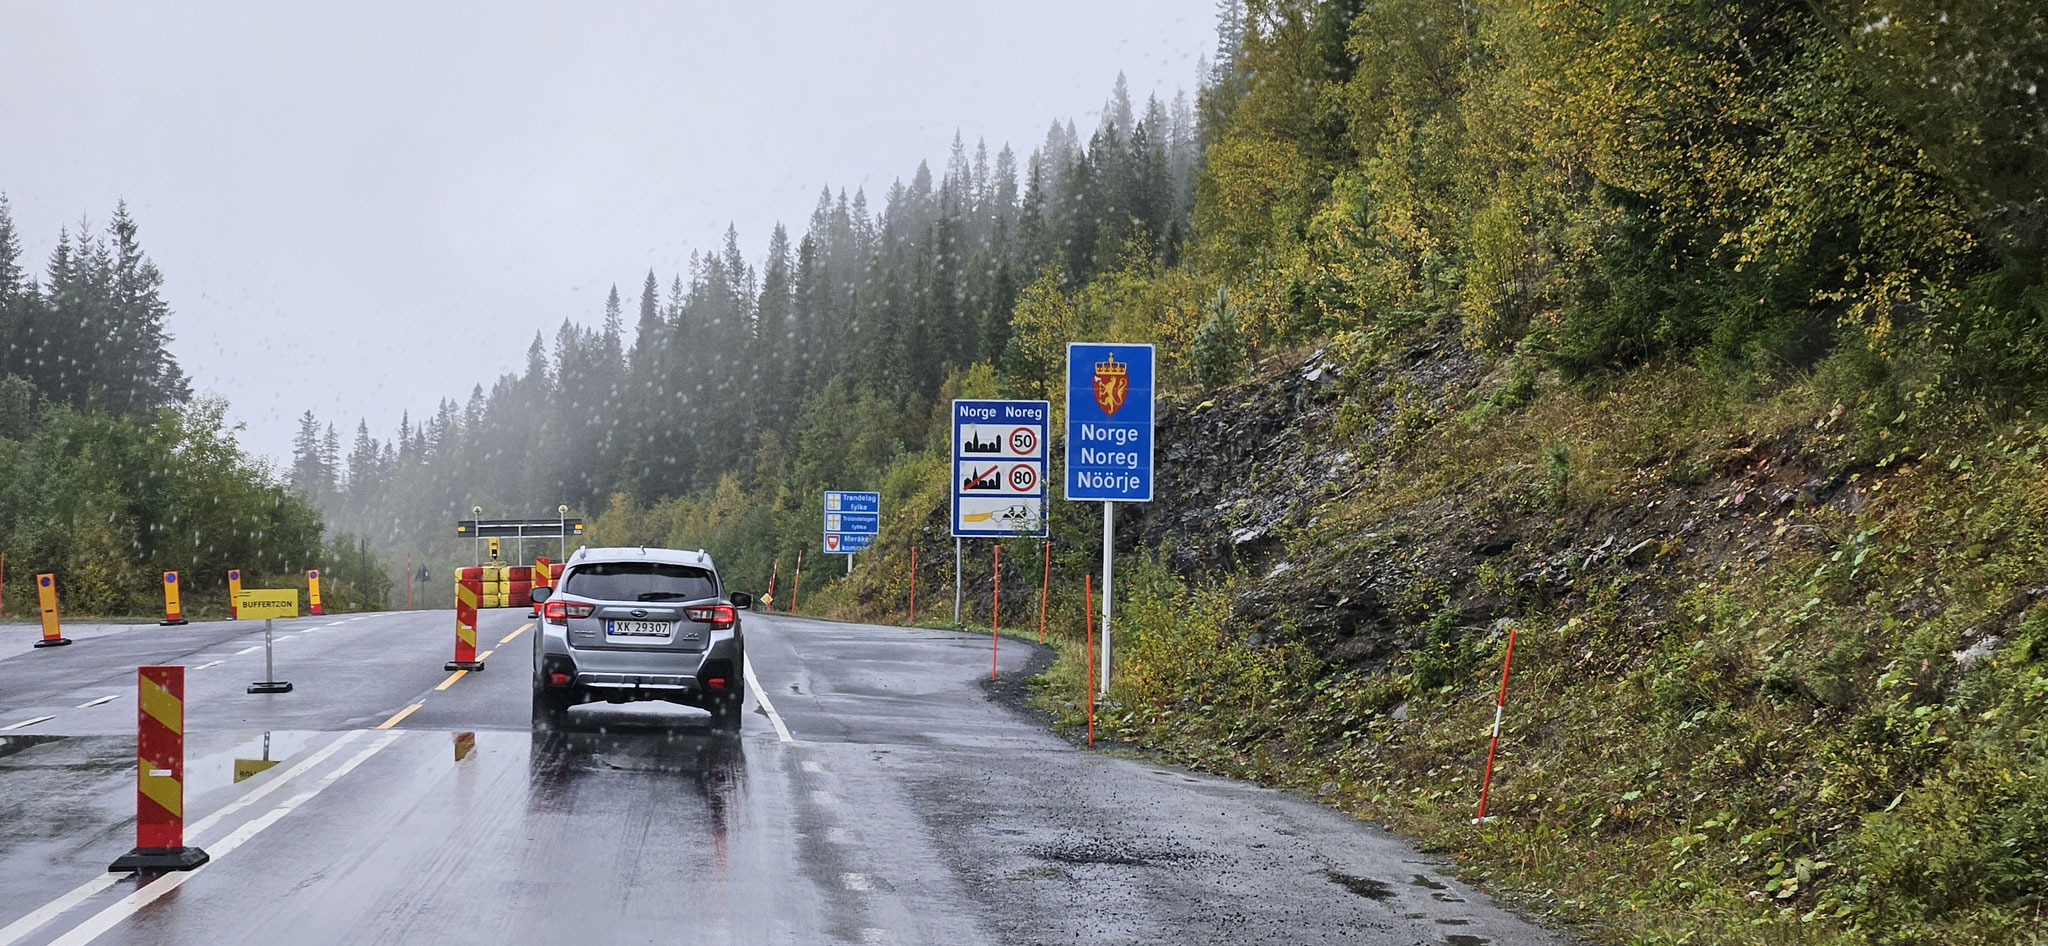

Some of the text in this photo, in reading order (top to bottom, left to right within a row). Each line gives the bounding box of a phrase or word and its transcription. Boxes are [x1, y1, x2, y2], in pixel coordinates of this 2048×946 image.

[960, 405, 1042, 420] Norge Noreg
[1014, 434, 1032, 448] 50
[1081, 423, 1139, 446] Norge
[1081, 447, 1138, 469] Noreg
[1013, 471, 1032, 485] 80
[1077, 471, 1140, 493] Nöörje
[843, 494, 877, 503] Trøndelag
[850, 503, 868, 511] fylke
[616, 621, 668, 633] XK 29307
